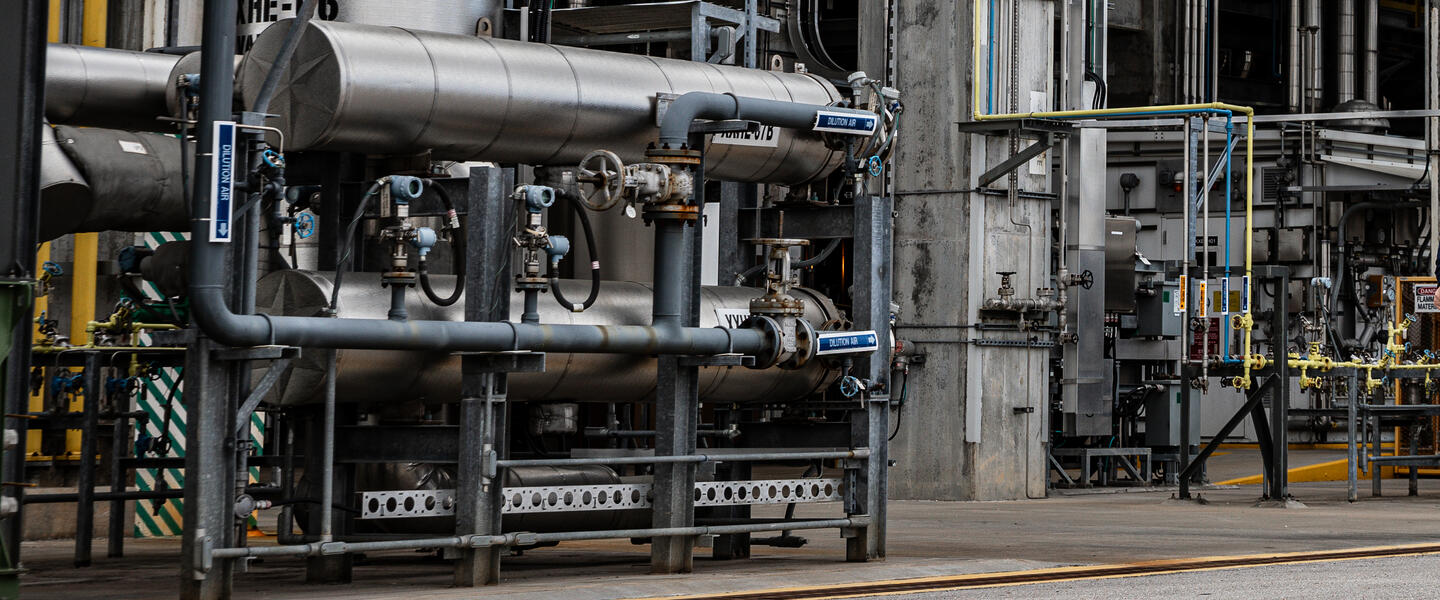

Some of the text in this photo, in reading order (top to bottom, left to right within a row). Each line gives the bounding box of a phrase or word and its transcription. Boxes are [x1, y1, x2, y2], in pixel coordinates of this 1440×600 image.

[827, 116, 856, 127] DILUTION AIR
[220, 144, 232, 201] DILUTION AIR
[829, 337, 859, 348] DILUTION AIR
